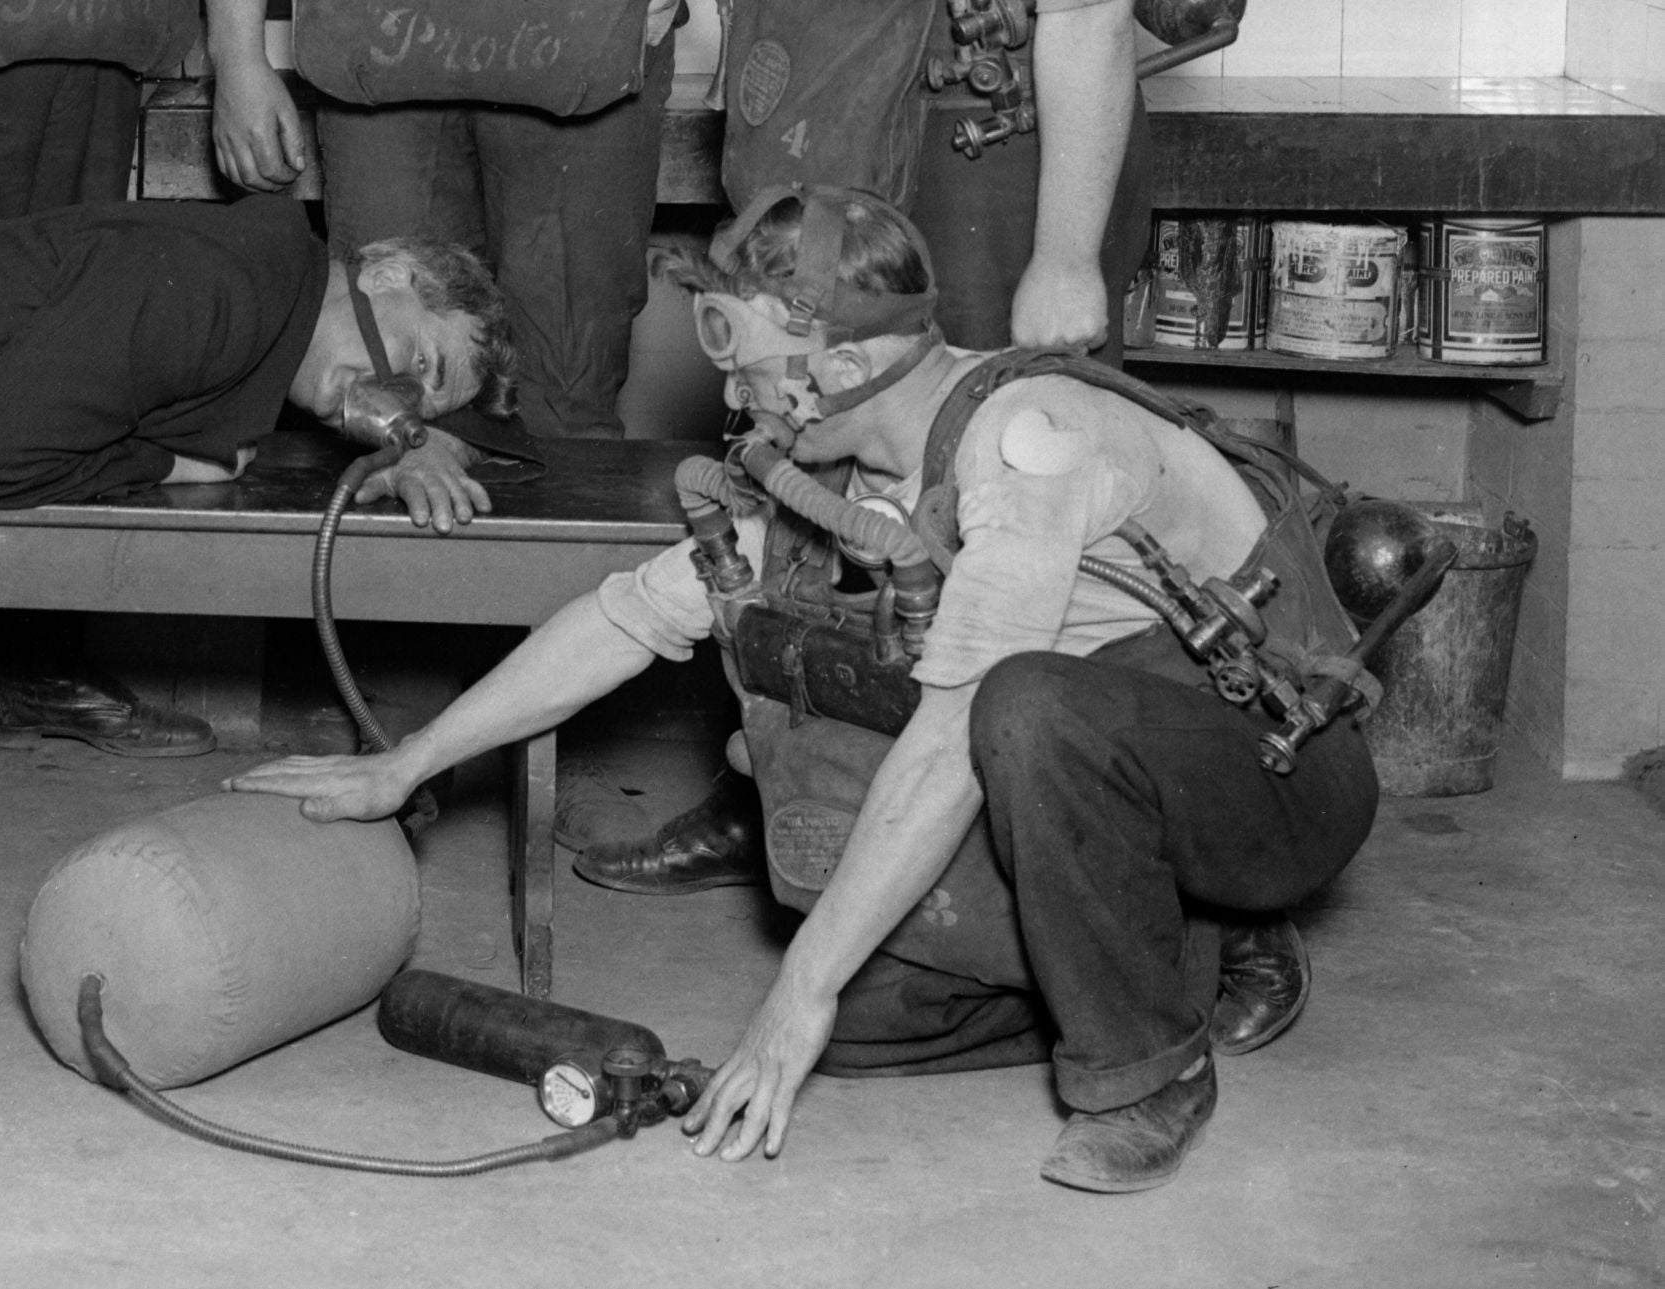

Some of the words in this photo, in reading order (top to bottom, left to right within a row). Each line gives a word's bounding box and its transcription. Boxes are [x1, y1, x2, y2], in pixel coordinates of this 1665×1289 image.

[780, 118, 811, 159] 4
[1451, 269, 1510, 285] PREPARED
[1512, 270, 1537, 284] PAINT
